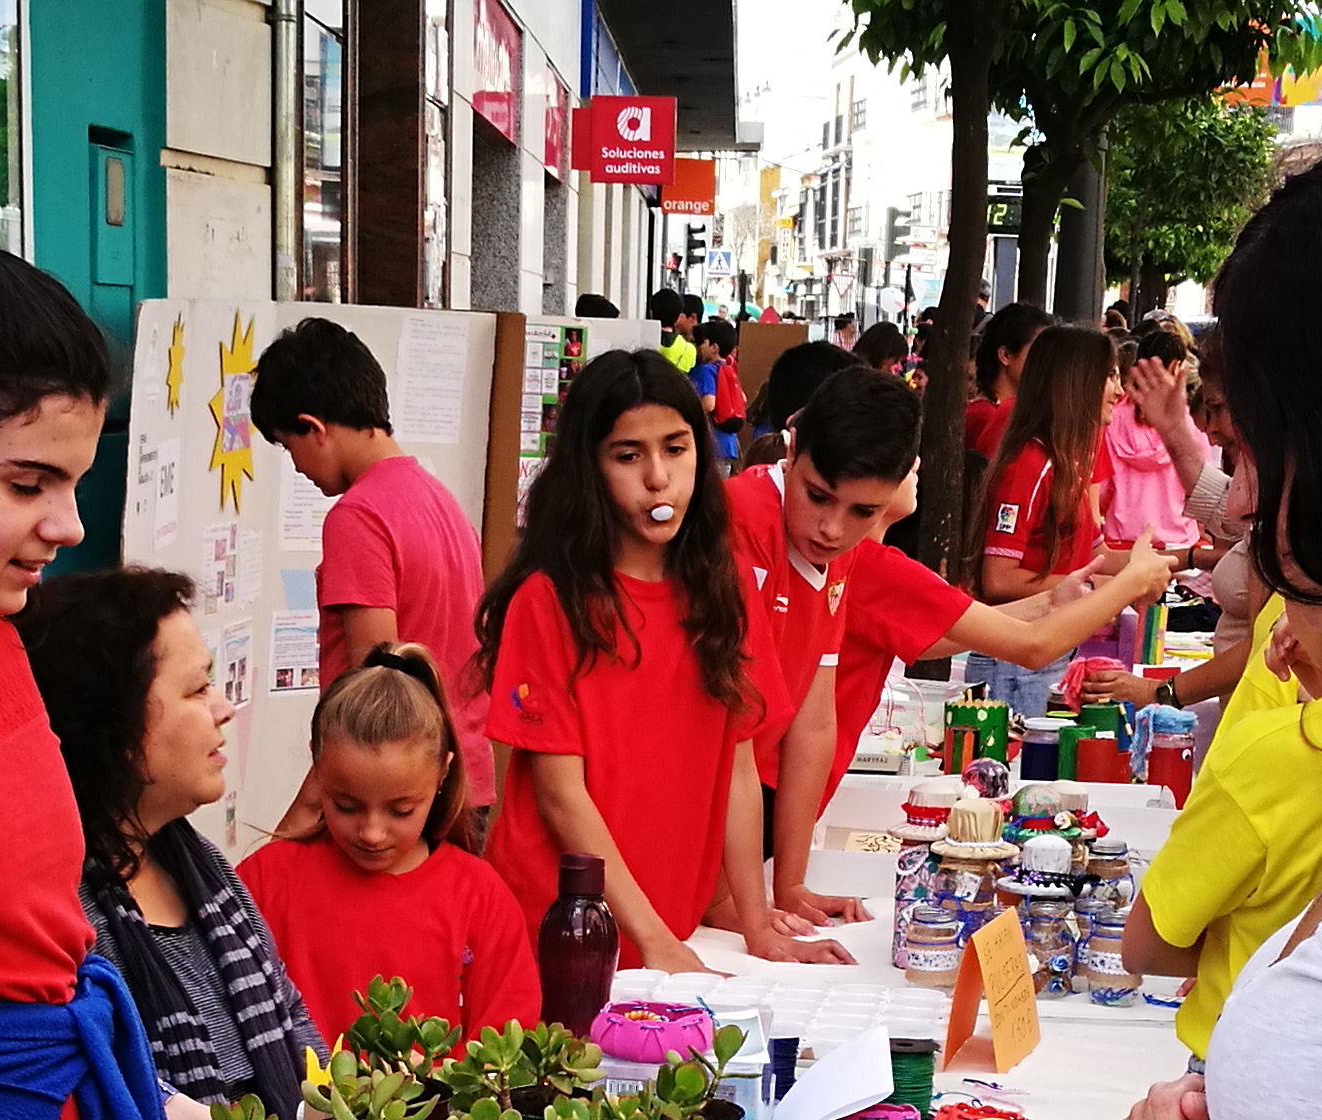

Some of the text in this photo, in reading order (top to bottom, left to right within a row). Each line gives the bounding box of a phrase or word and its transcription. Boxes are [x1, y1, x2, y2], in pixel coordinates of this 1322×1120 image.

[601, 146, 665, 159] Soluciones
[604, 163, 661, 175] auditivas
[663, 199, 710, 214] orange
